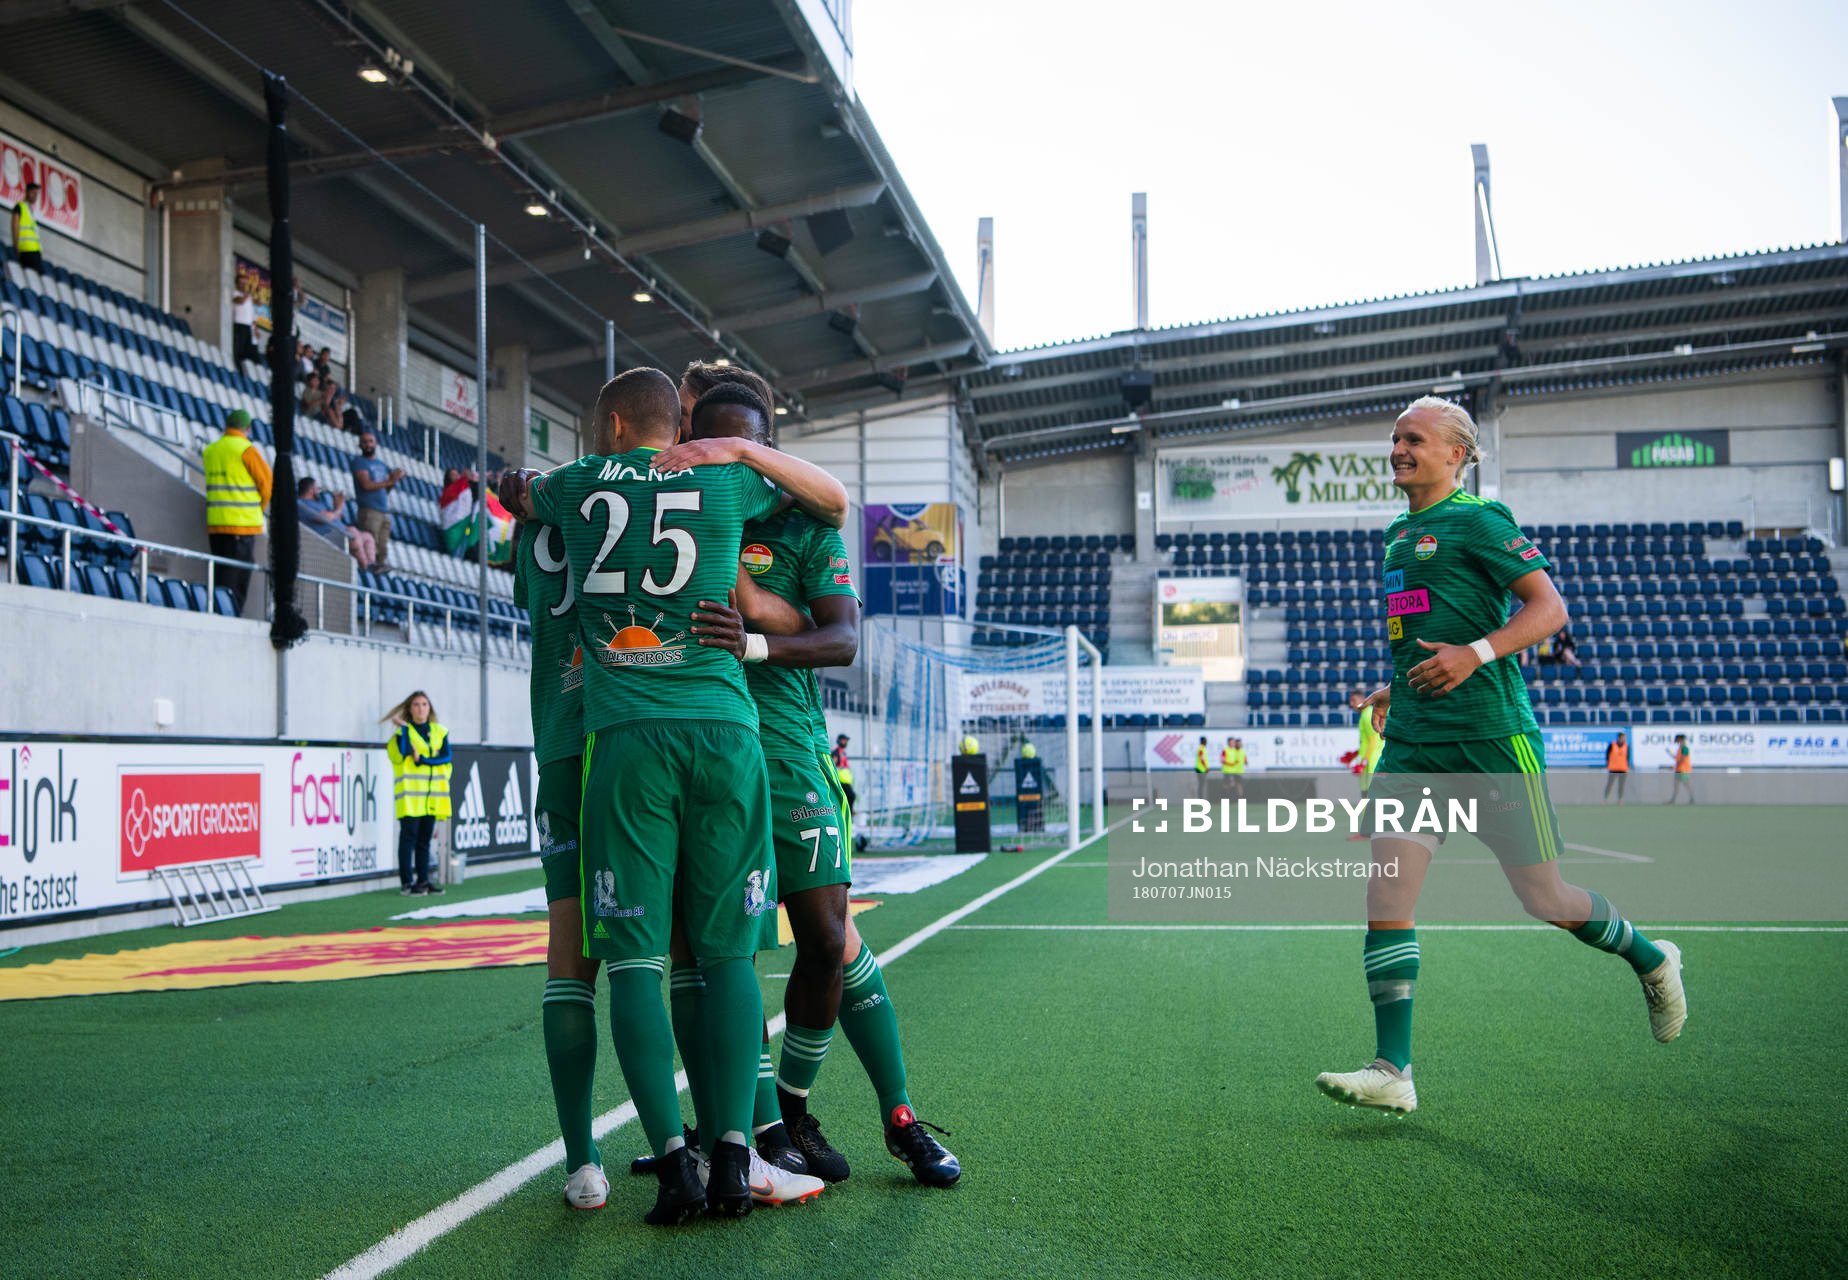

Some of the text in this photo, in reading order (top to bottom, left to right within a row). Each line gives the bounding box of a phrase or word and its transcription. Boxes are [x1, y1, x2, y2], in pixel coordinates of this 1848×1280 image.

[579, 489, 701, 597] 25
[1390, 594, 1424, 612] STORA
[291, 752, 377, 836] fastlink
[153, 803, 258, 838] SPORTGROSSEN
[455, 818, 490, 850] adidas
[495, 816, 528, 845] adidas
[318, 848, 327, 874] Be
[331, 845, 345, 872] The
[800, 826, 841, 873] 77
[24, 870, 77, 912] Fastest
